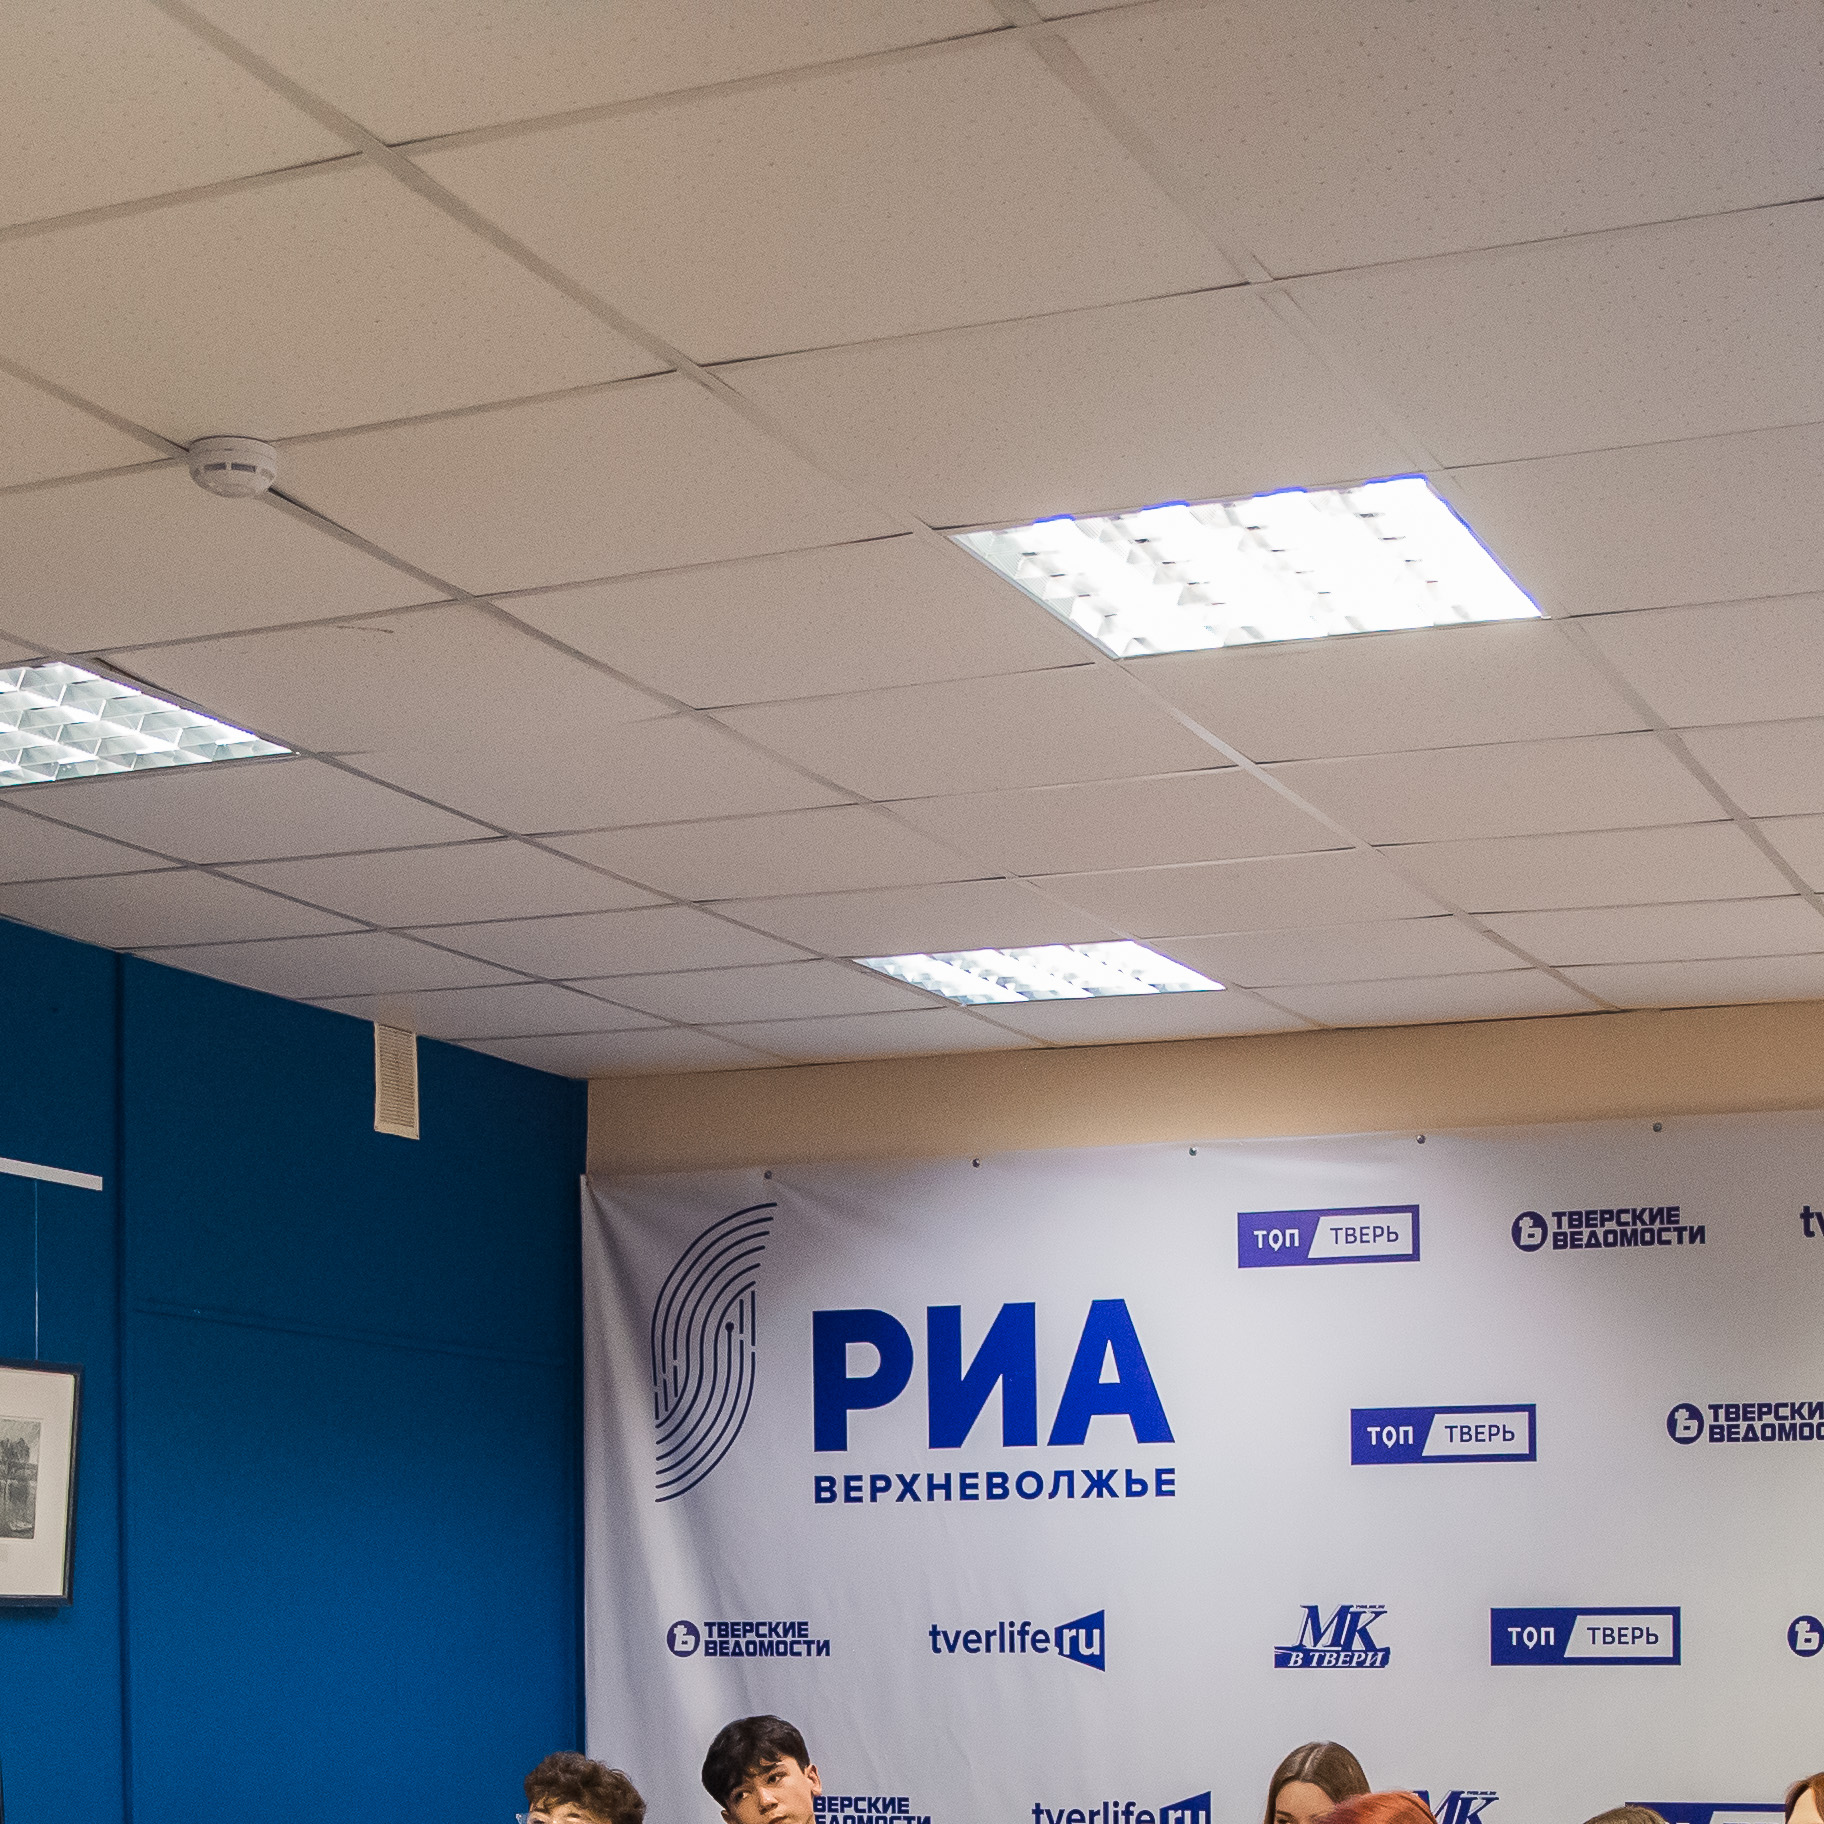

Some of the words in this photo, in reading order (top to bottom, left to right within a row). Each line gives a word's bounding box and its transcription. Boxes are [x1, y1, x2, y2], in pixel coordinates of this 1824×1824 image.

[1553, 1206, 1680, 1229] ТВЕРСКИЕ
[1254, 1229, 1299, 1251] ТОП
[1330, 1226, 1398, 1244] ТВЕРЬ
[1553, 1226, 1705, 1249] ВЕДОМОСТИ
[812, 1299, 1175, 1452] РИА
[1367, 1426, 1413, 1448] ТОП
[1445, 1424, 1514, 1442] ТВЕРЬ
[814, 1468, 1175, 1504] ВЕРХНЕВОЛЖЬЕ
[704, 1620, 809, 1639] ТВЕРСКИЕ
[1299, 1605, 1387, 1650] МК
[1508, 1627, 1554, 1649] ТОП
[1587, 1627, 1658, 1644] ТВЕРЬ
[705, 1640, 830, 1657] ВЕДОМОСТИ
[1288, 1652, 1304, 1668] В
[1309, 1651, 1384, 1668] ТВЕРИ
[813, 1796, 910, 1814] ВЕРСКИЕ
